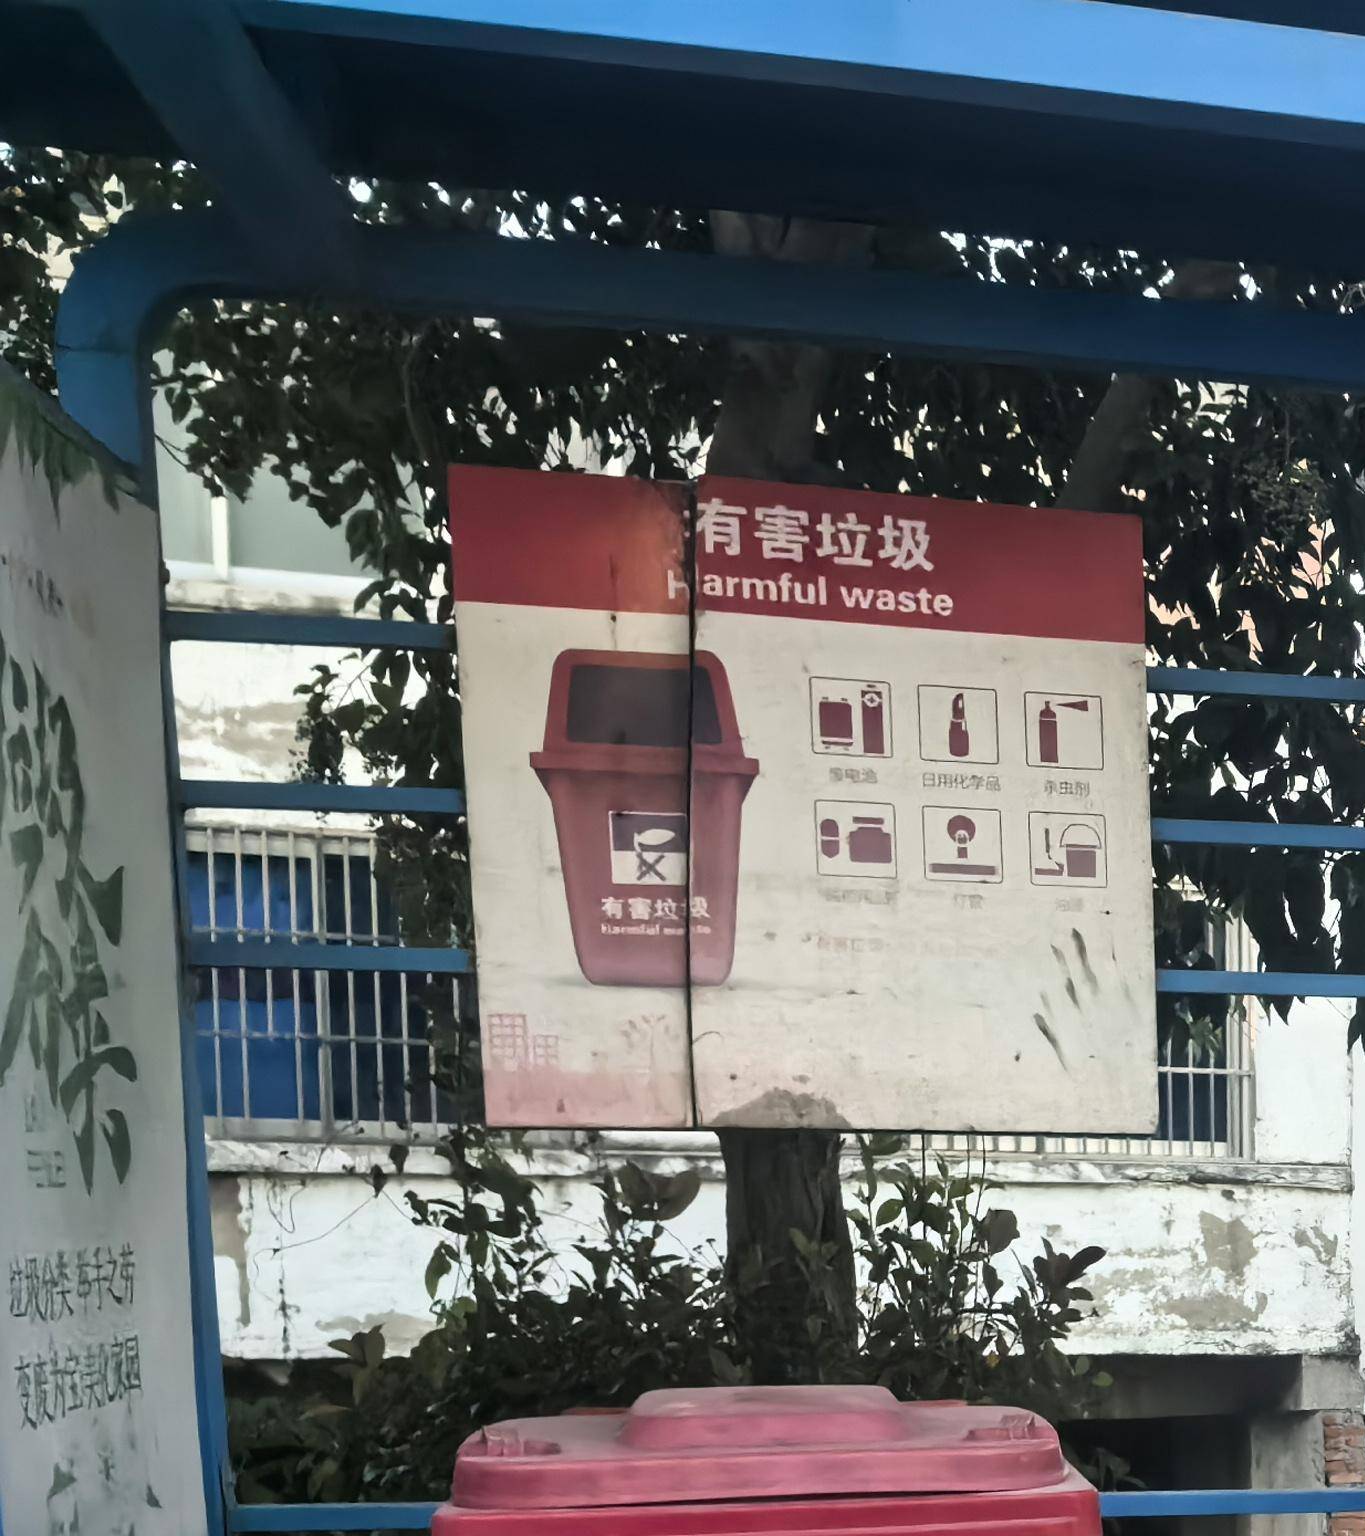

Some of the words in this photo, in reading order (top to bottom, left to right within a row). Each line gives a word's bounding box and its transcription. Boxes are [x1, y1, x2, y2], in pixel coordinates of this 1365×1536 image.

[684, 498, 934, 572] 有害垃圾
[840, 585, 953, 616] waste
[922, 773, 1002, 792] 日用化学品
